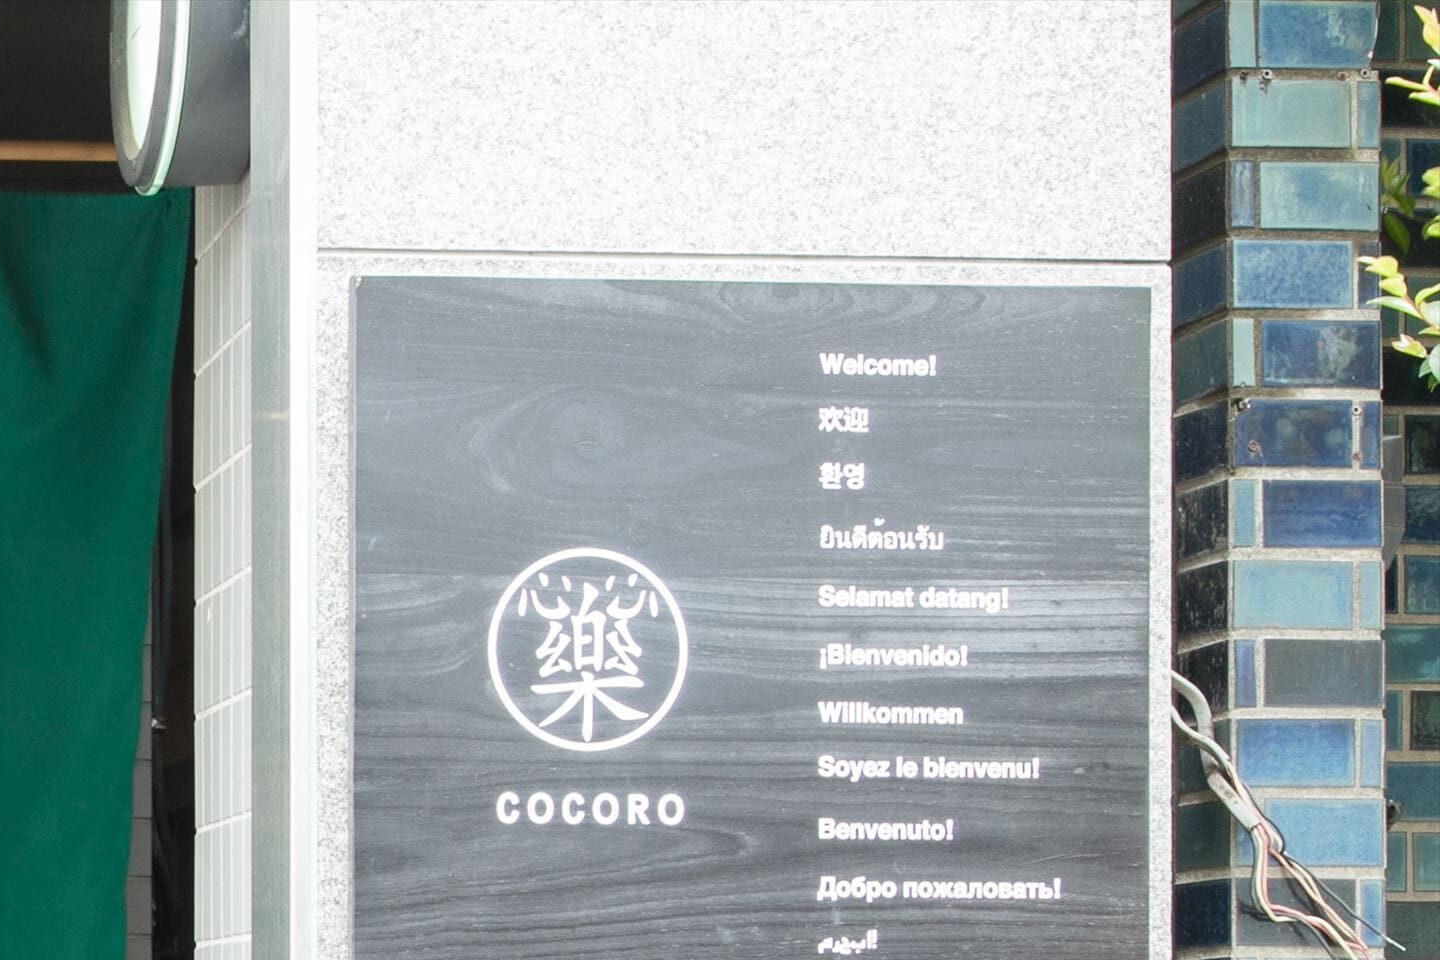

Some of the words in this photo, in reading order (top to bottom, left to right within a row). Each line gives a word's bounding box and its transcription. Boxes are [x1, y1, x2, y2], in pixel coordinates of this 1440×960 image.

[819, 352, 937, 377] Welcome!
[818, 405, 869, 433] 欢迎
[818, 462, 865, 490] 환영
[819, 517, 944, 550] ยินดีต้อนรับ
[818, 584, 915, 608] Selamat
[919, 586, 1010, 614] datang!
[819, 643, 969, 670] ¡Bienvenido!
[817, 701, 964, 725] Willkommen
[817, 754, 891, 783] Soyez
[896, 755, 919, 779] le
[923, 756, 1040, 779] bienvenu!
[496, 791, 685, 826] COCORO
[818, 817, 954, 841] Benvenuto!
[816, 875, 898, 903] Добро
[902, 877, 1061, 900] пожаловать!
